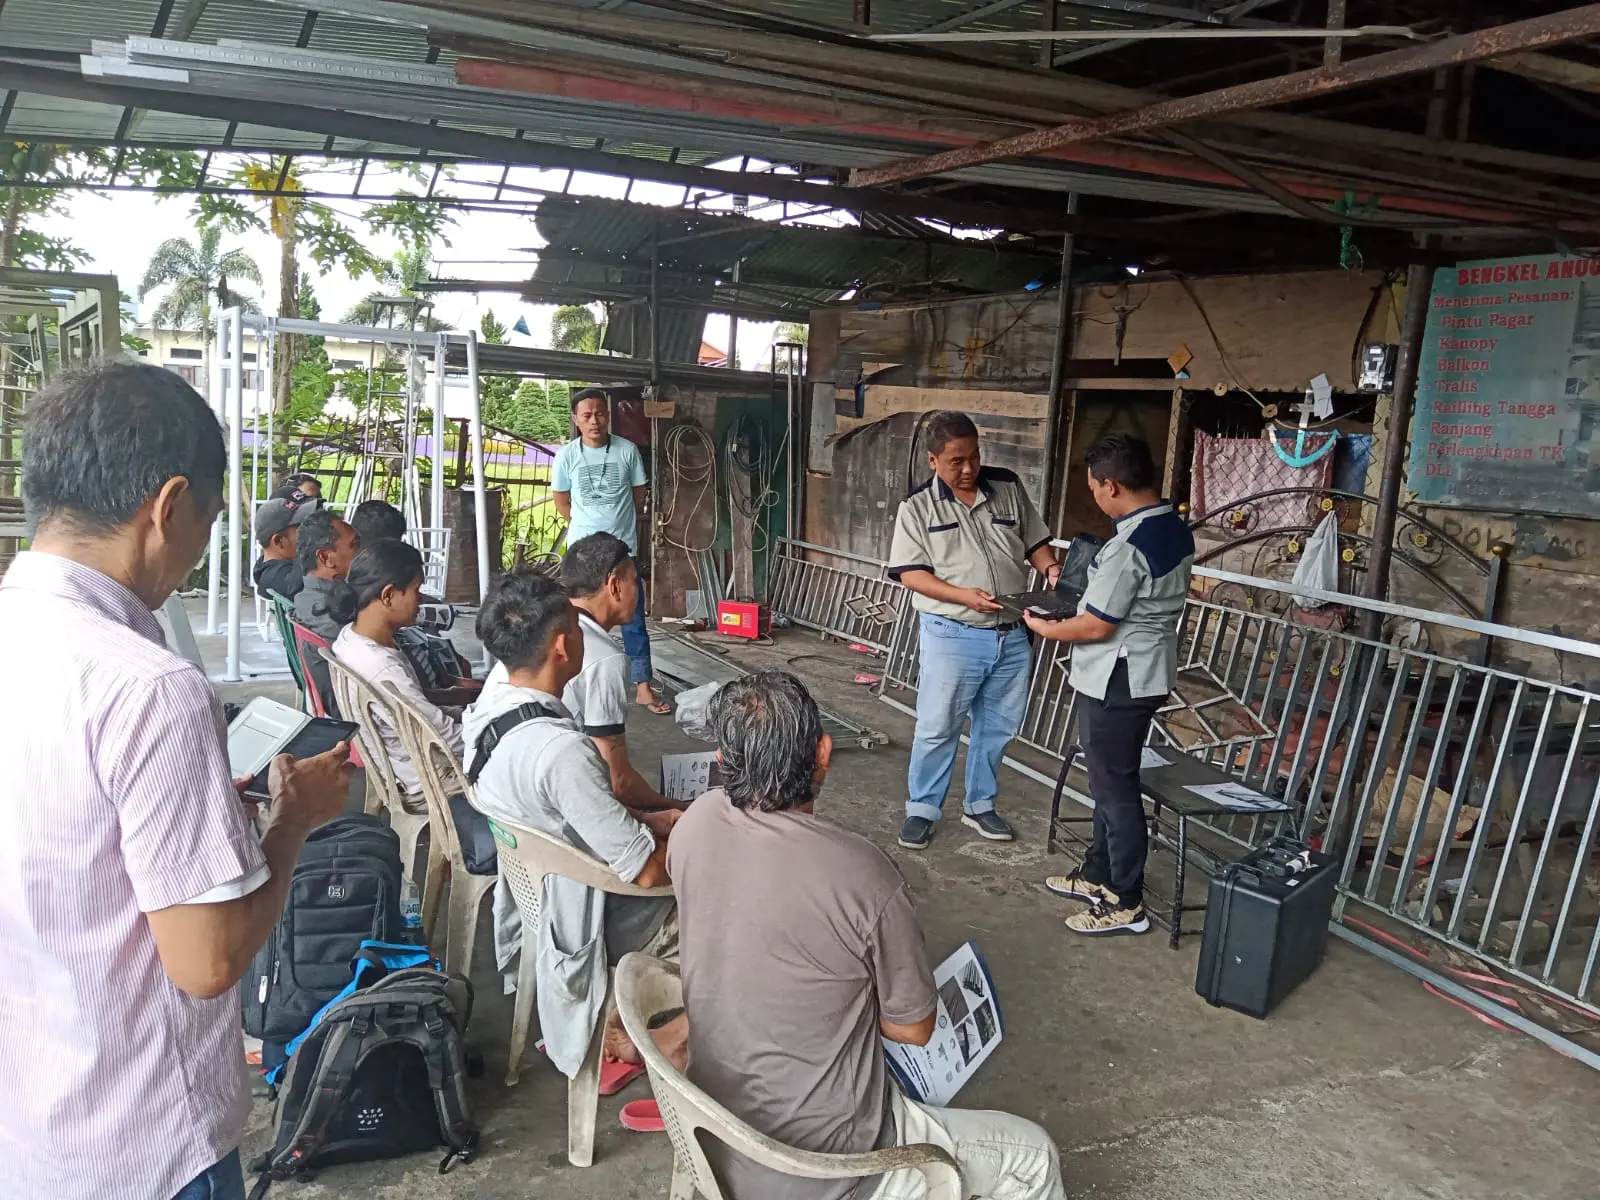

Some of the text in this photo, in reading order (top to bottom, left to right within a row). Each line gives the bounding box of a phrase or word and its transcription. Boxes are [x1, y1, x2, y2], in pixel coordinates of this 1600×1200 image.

[1457, 263, 1539, 286] BENGKEL
[1433, 295, 1503, 308] Menerima
[1442, 313, 1535, 330] Pintu Pagar
[1439, 337, 1499, 352] Kanopy
[1437, 357, 1490, 372] Balkon
[1435, 379, 1478, 393] Tralis
[1498, 401, 1556, 418] Tangga
[1431, 422, 1493, 439] Ranjang
